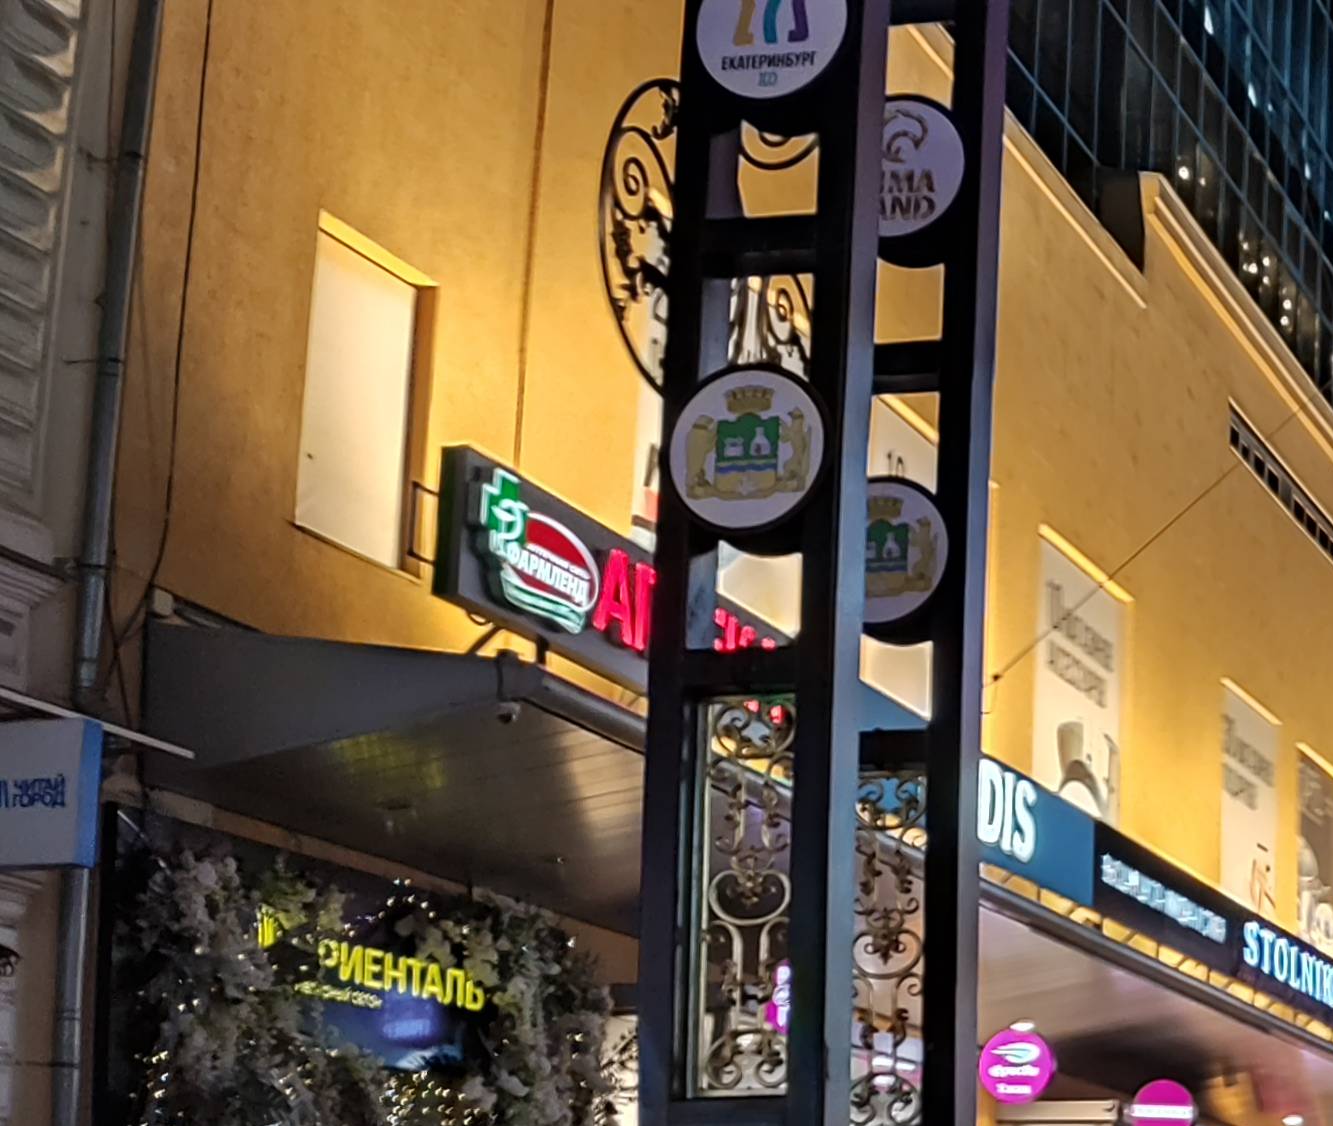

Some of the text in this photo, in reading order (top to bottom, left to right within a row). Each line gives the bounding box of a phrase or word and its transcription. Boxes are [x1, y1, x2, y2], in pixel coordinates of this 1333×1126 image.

[721, 51, 817, 71] ЕКАТЕРИНБУРГ
[880, 169, 936, 194] IMA
[879, 195, 936, 221] AND
[506, 541, 590, 607] ФАРМЛЕНД
[14, 773, 66, 793] ЧИТАЙ
[12, 792, 66, 808] ГОРОД
[977, 757, 1037, 863] DIS
[317, 937, 485, 1012] РИЕНТАЛЬ
